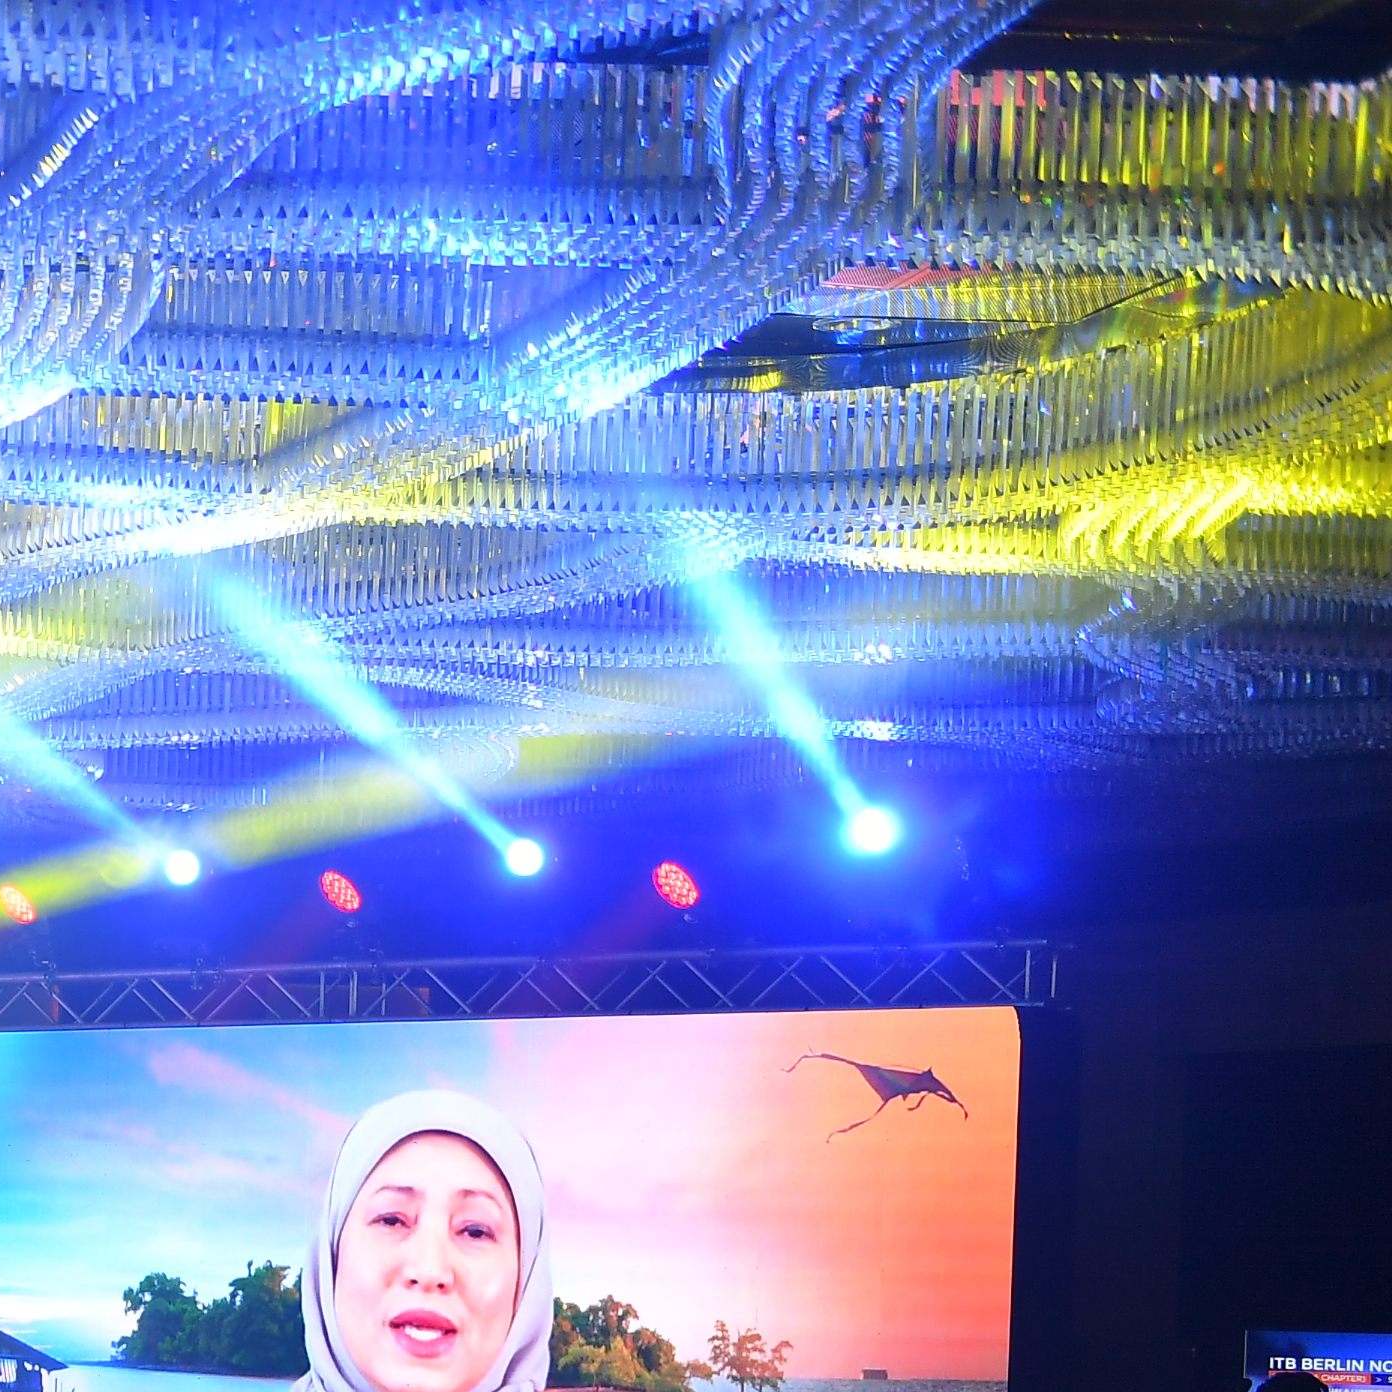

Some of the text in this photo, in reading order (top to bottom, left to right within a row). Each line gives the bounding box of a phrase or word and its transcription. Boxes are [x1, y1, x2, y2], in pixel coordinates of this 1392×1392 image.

[1269, 1357, 1297, 1370] ITB
[1301, 1358, 1364, 1372] BERLIN
[1321, 1374, 1366, 1384] CHAPTER)
